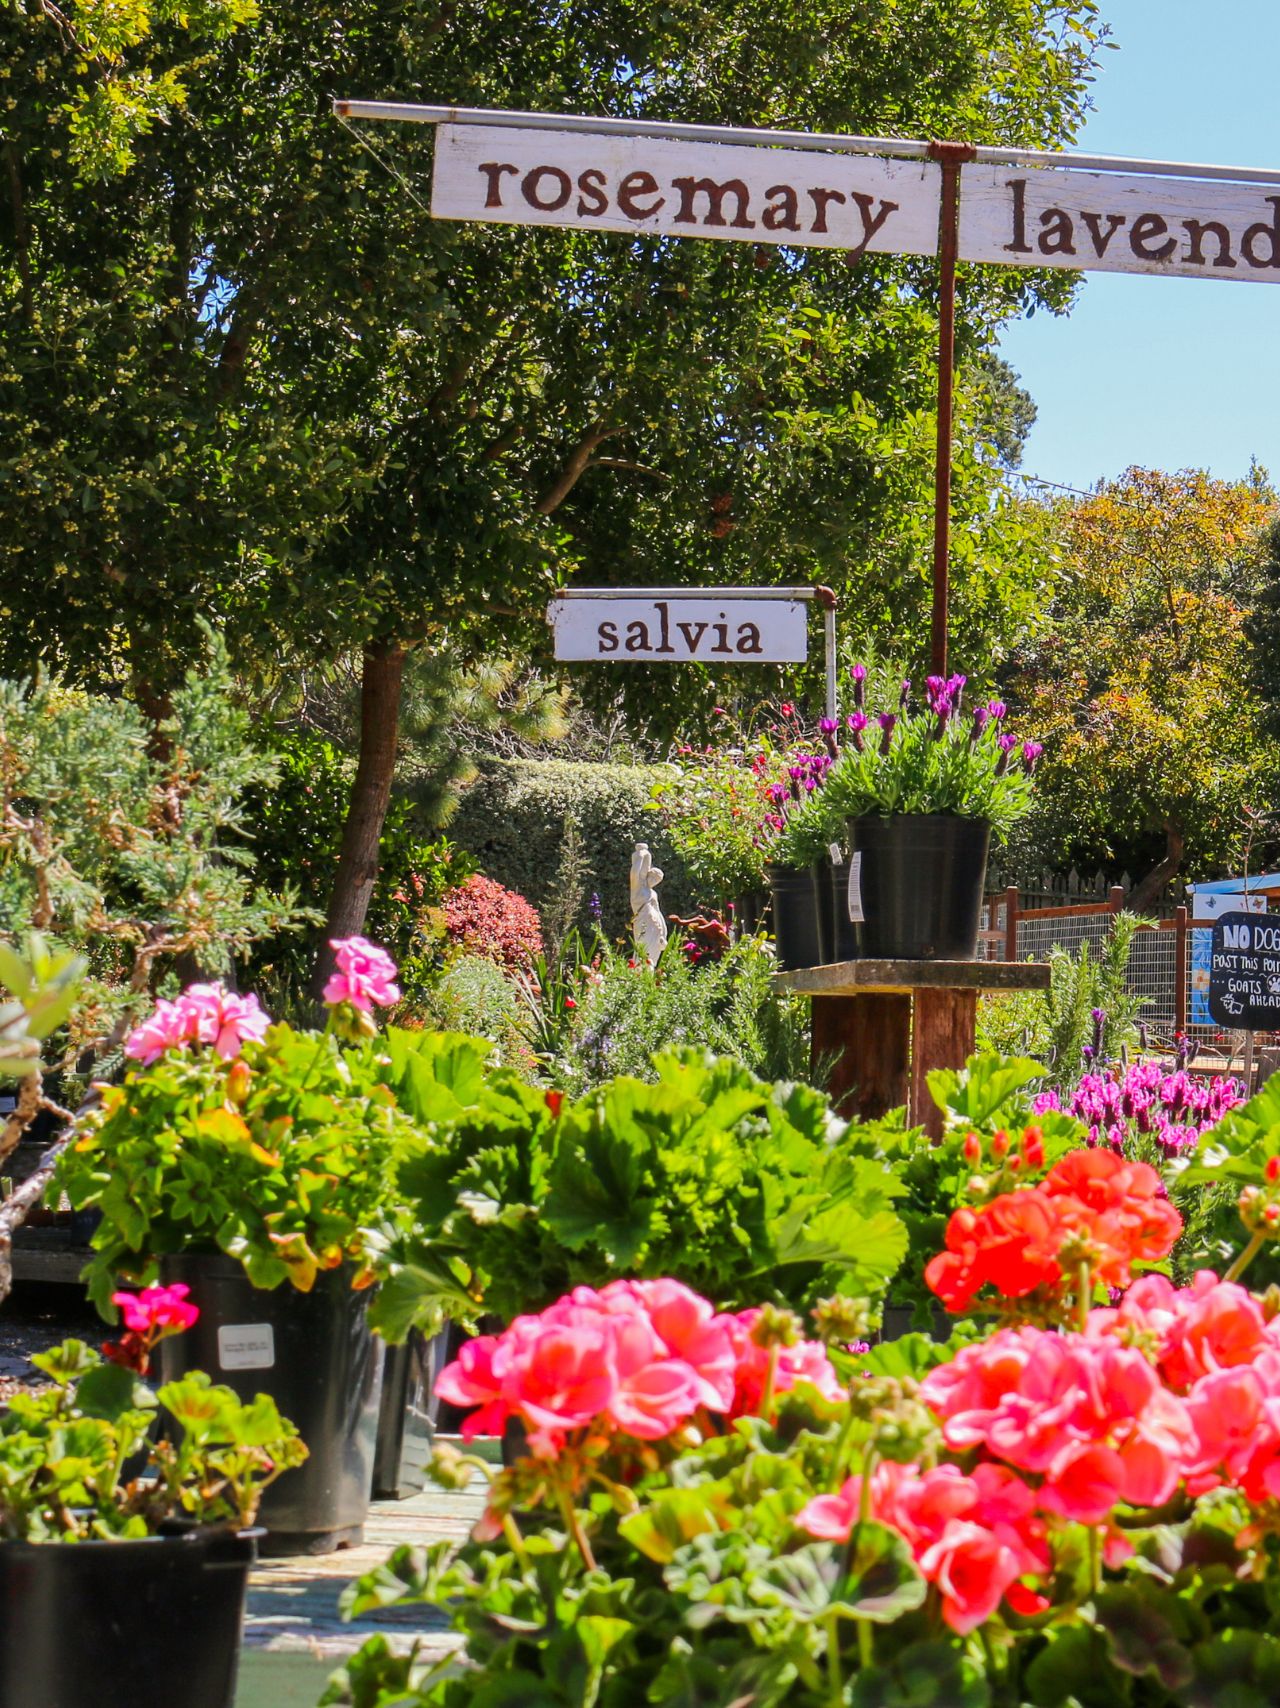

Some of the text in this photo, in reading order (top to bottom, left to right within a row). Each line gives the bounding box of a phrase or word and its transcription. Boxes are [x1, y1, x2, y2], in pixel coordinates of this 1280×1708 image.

[477, 160, 900, 268] rosemary
[597, 601, 764, 654] salvia
[1222, 924, 1251, 949] NO
[1228, 977, 1262, 995] GOATS
